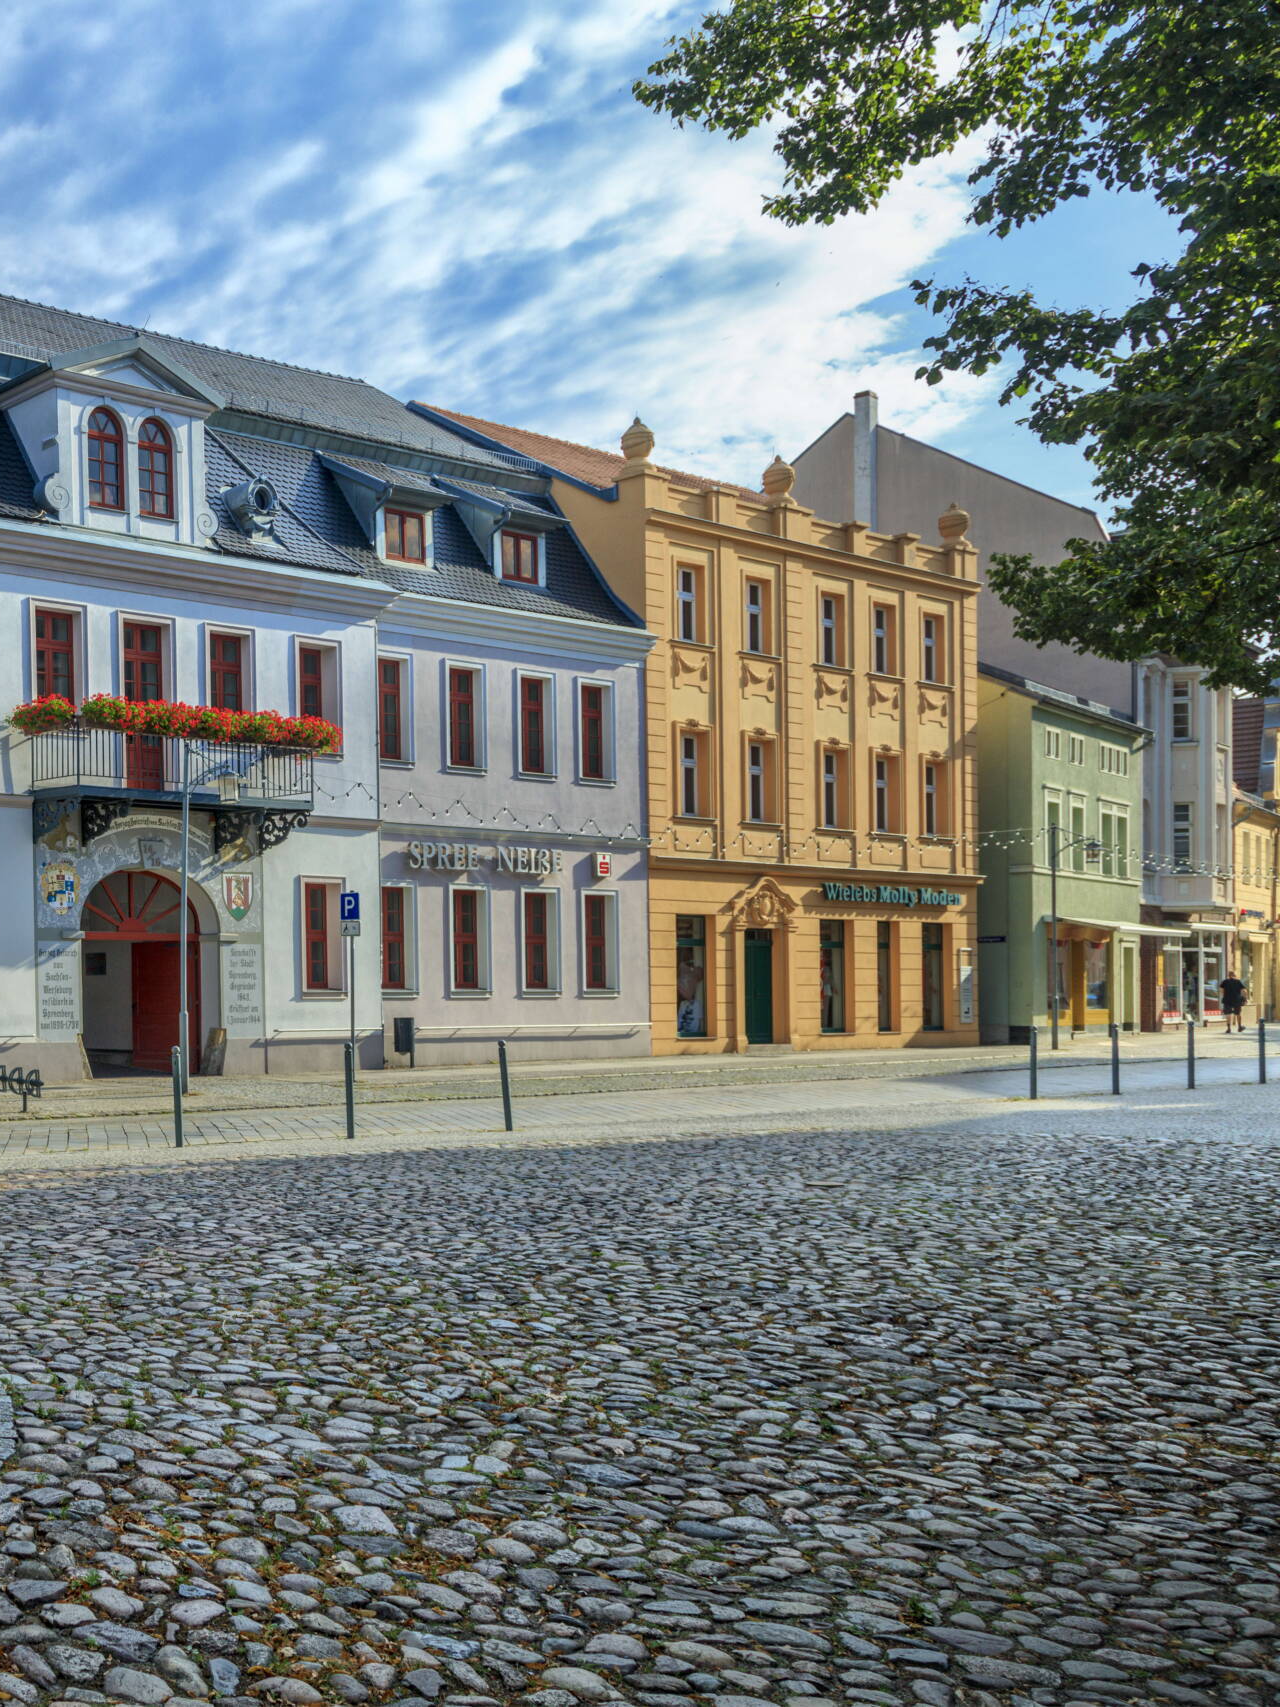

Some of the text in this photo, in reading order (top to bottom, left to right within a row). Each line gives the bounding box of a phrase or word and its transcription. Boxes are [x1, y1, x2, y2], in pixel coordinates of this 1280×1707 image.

[408, 841, 480, 871] SPREE
[344, 896, 355, 917] P
[824, 882, 962, 908] Wielebs Molly Moden
